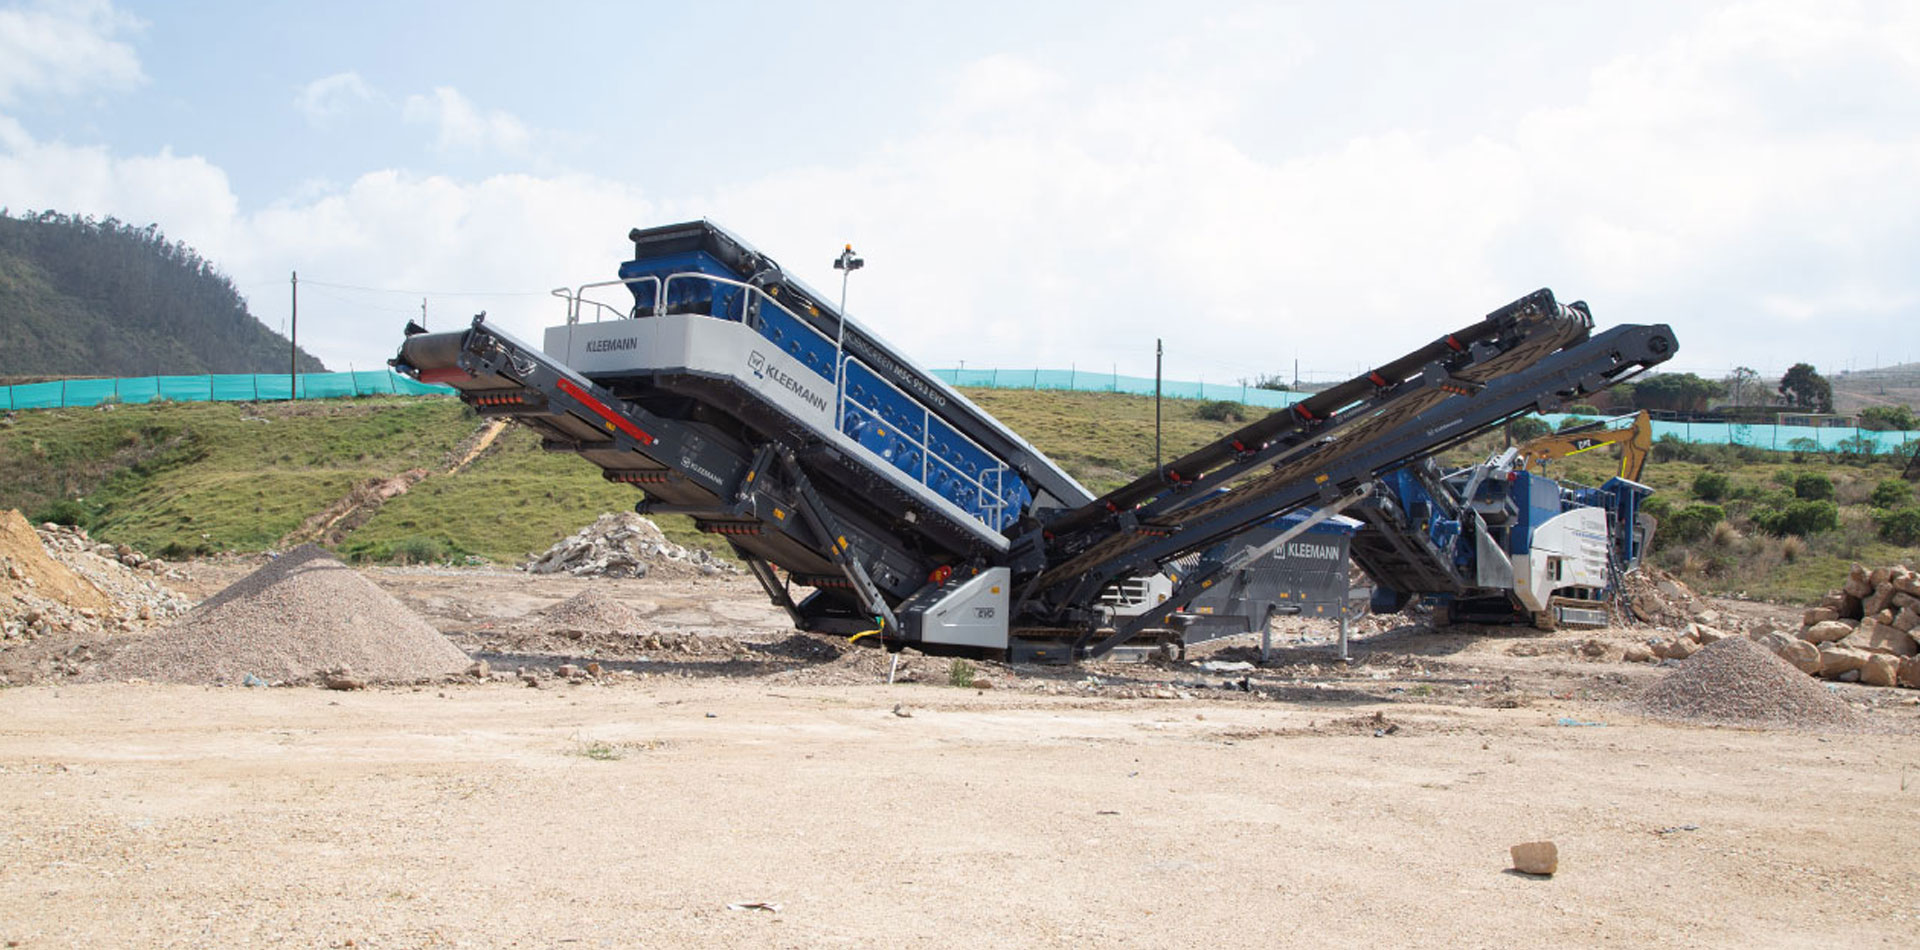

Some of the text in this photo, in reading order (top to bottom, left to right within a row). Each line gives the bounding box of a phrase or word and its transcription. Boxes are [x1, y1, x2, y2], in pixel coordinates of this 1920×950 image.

[586, 337, 638, 353] KLEEMANN
[766, 364, 827, 412] KLEEMANN
[1288, 542, 1339, 560] KLEEMANN
